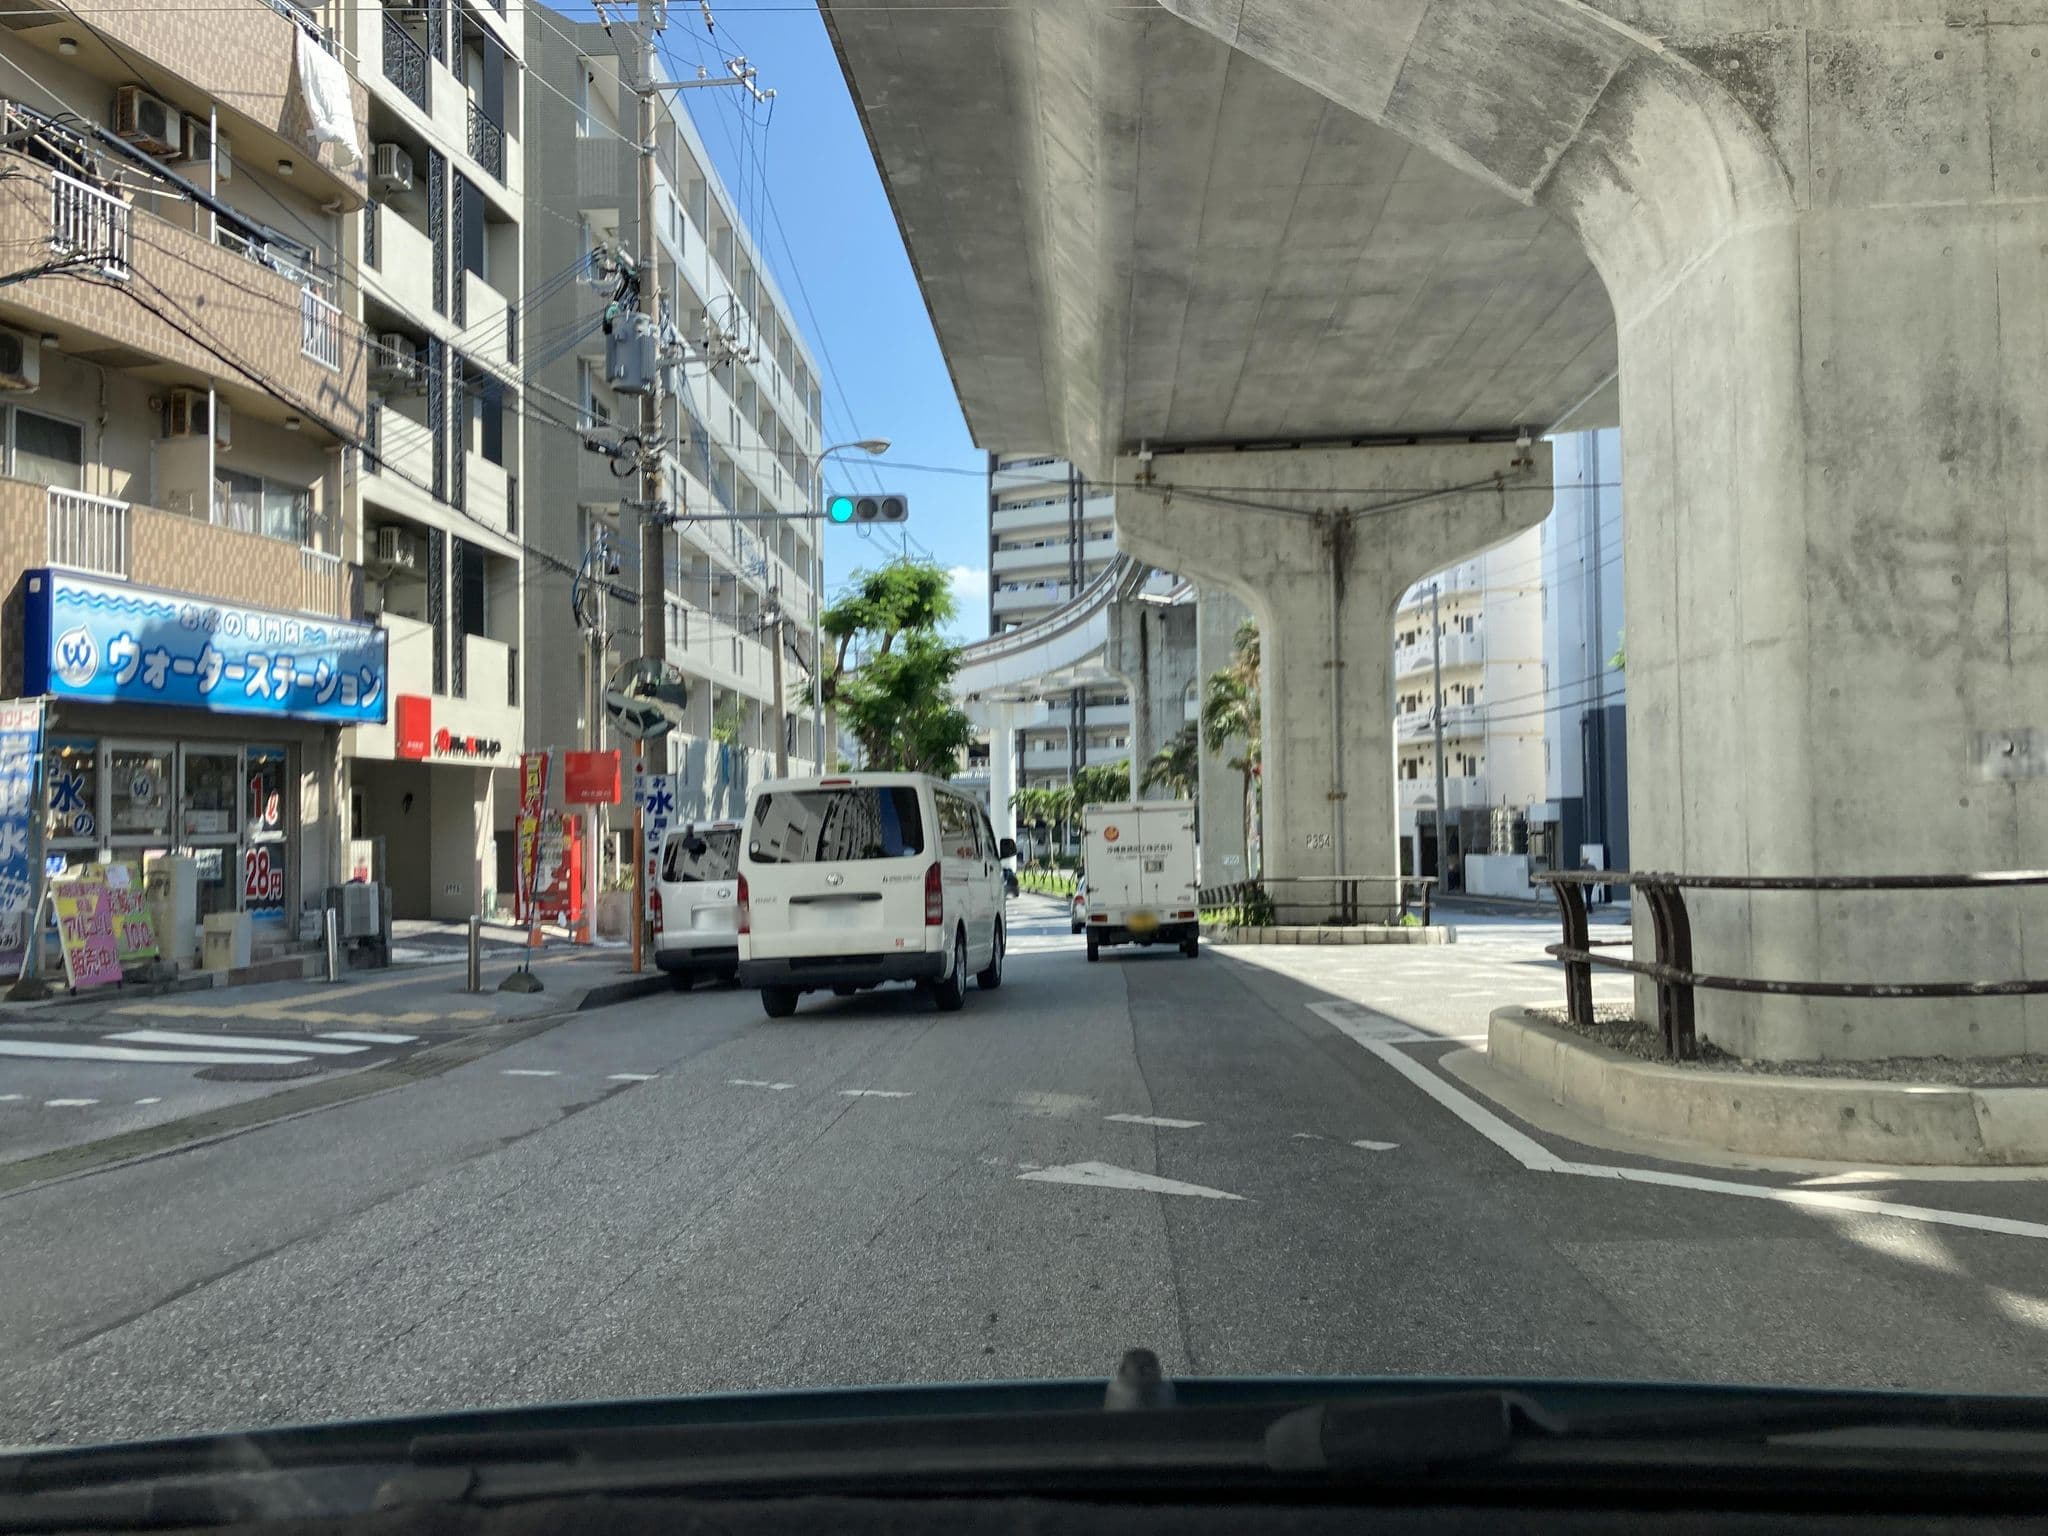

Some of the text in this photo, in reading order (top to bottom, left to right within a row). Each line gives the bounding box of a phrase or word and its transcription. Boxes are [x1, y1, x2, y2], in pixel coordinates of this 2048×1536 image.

[179, 603, 301, 646] お水の専門店
[108, 633, 381, 709] ウォーターステーション
[245, 847, 283, 900] 28円
